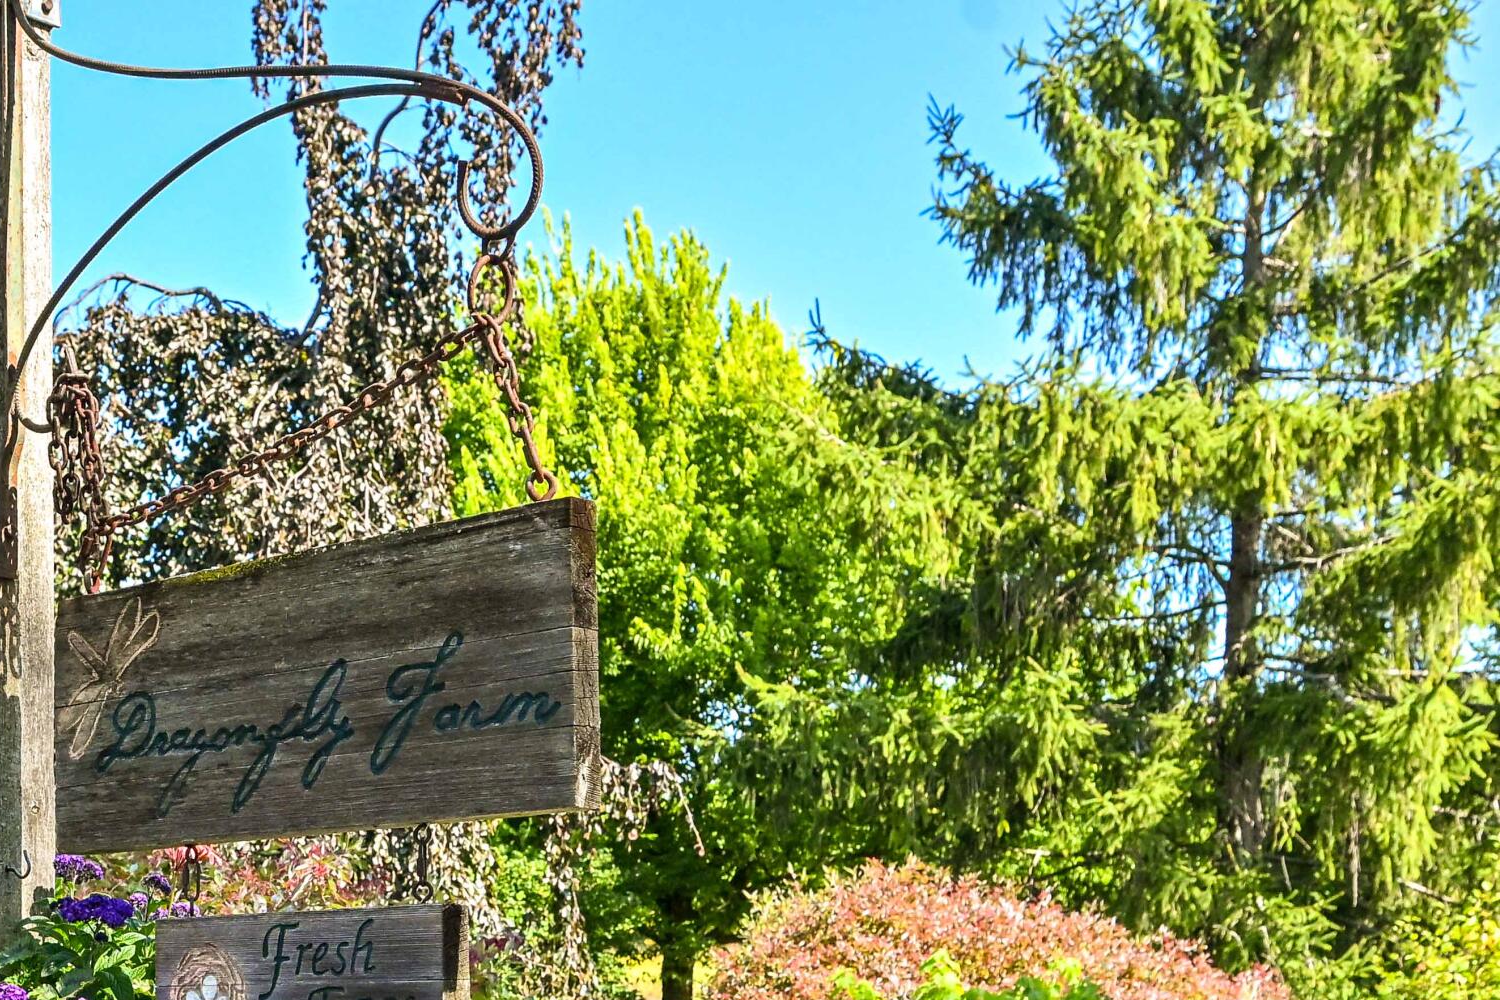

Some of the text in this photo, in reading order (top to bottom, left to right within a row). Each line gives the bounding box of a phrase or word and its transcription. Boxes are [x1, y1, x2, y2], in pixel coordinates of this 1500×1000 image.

[95, 630, 562, 818] Dragonfly Farm
[258, 918, 375, 1000] Fresh
